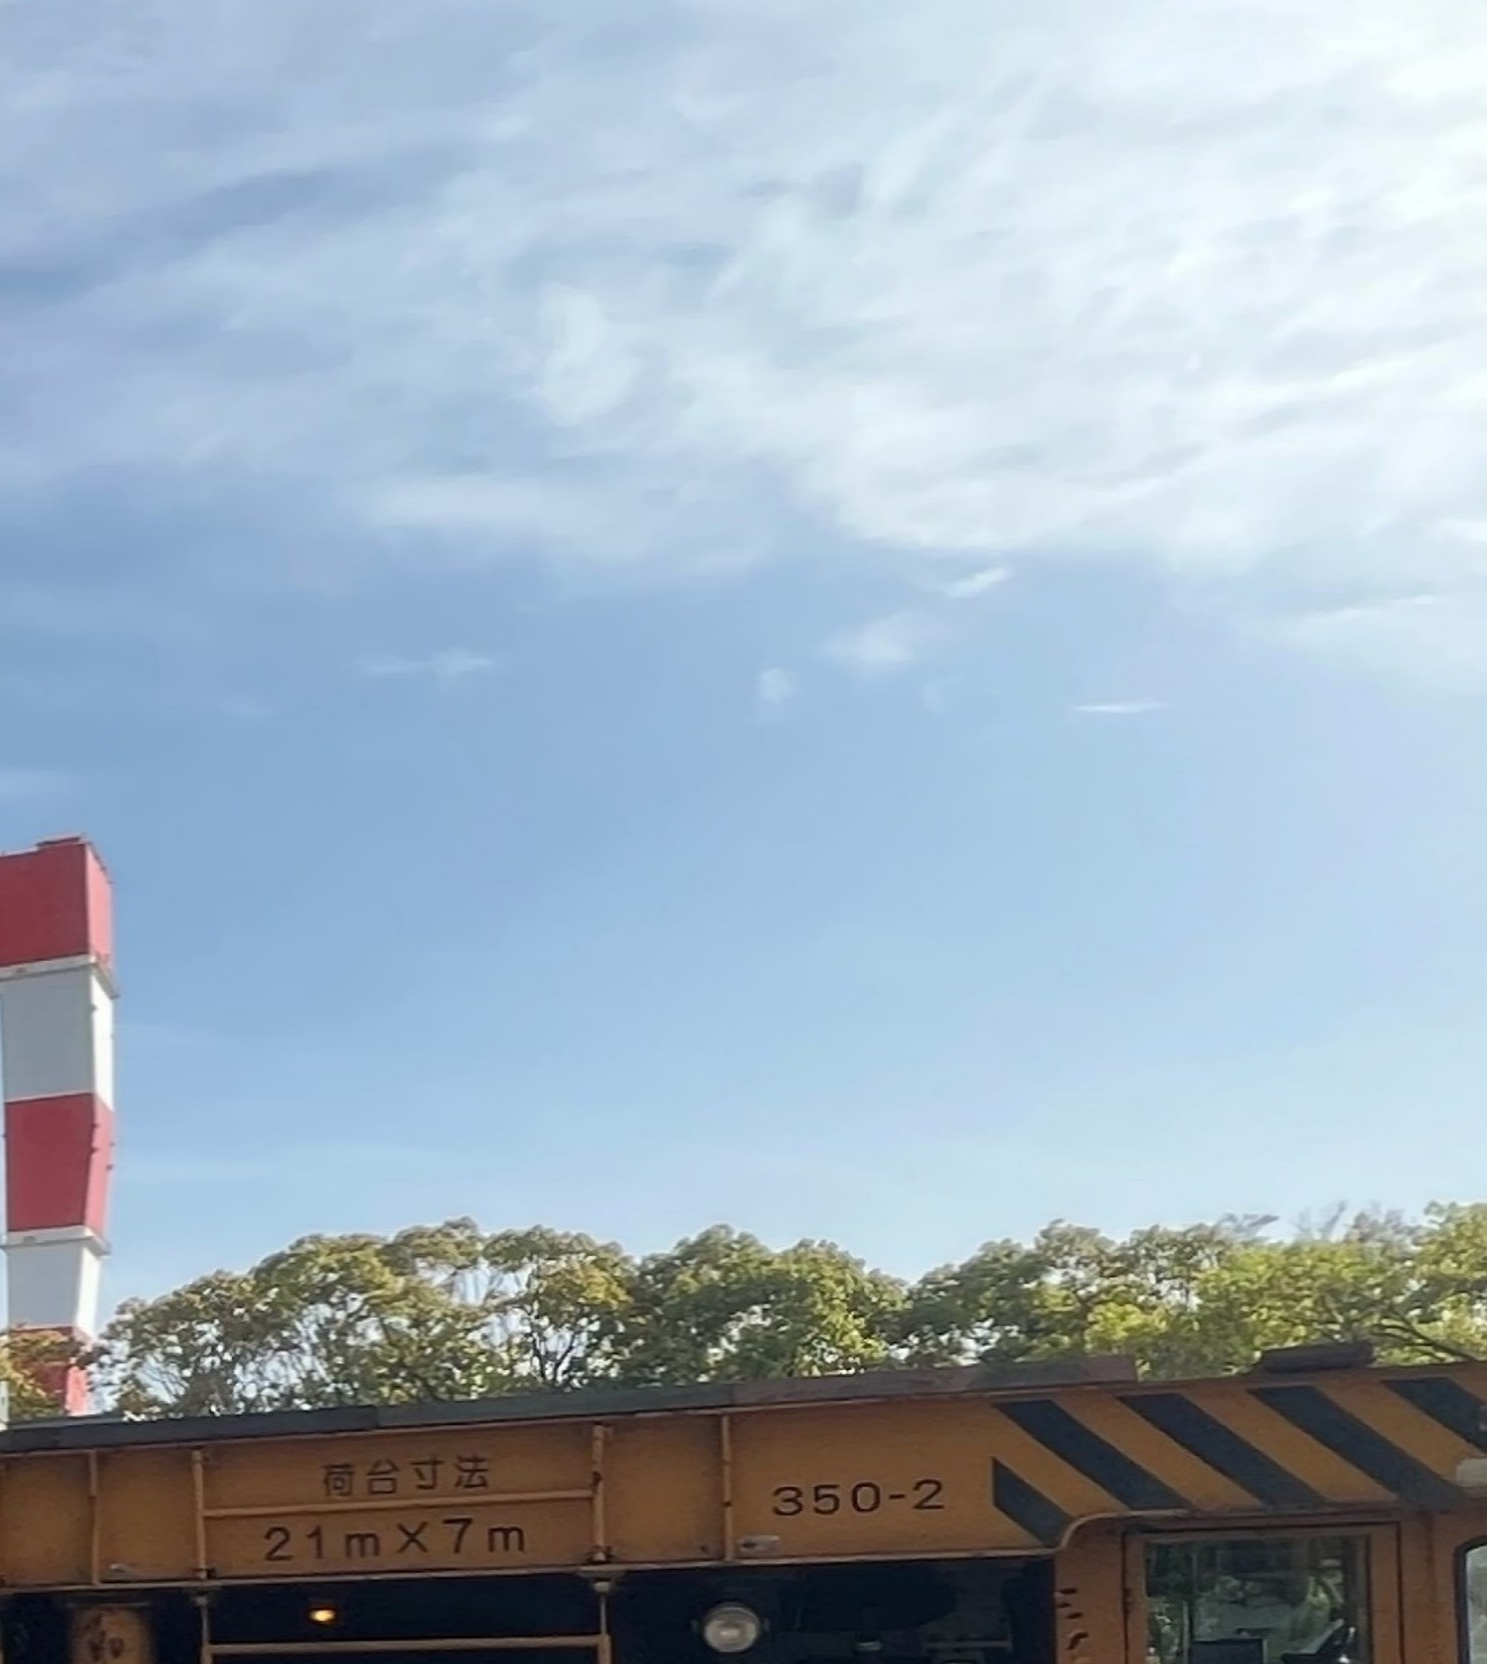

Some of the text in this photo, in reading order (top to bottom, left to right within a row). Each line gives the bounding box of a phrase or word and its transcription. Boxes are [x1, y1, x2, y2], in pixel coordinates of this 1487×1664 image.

[321, 1454, 491, 1498] 荷台寸法
[771, 1478, 946, 1517] 350-2
